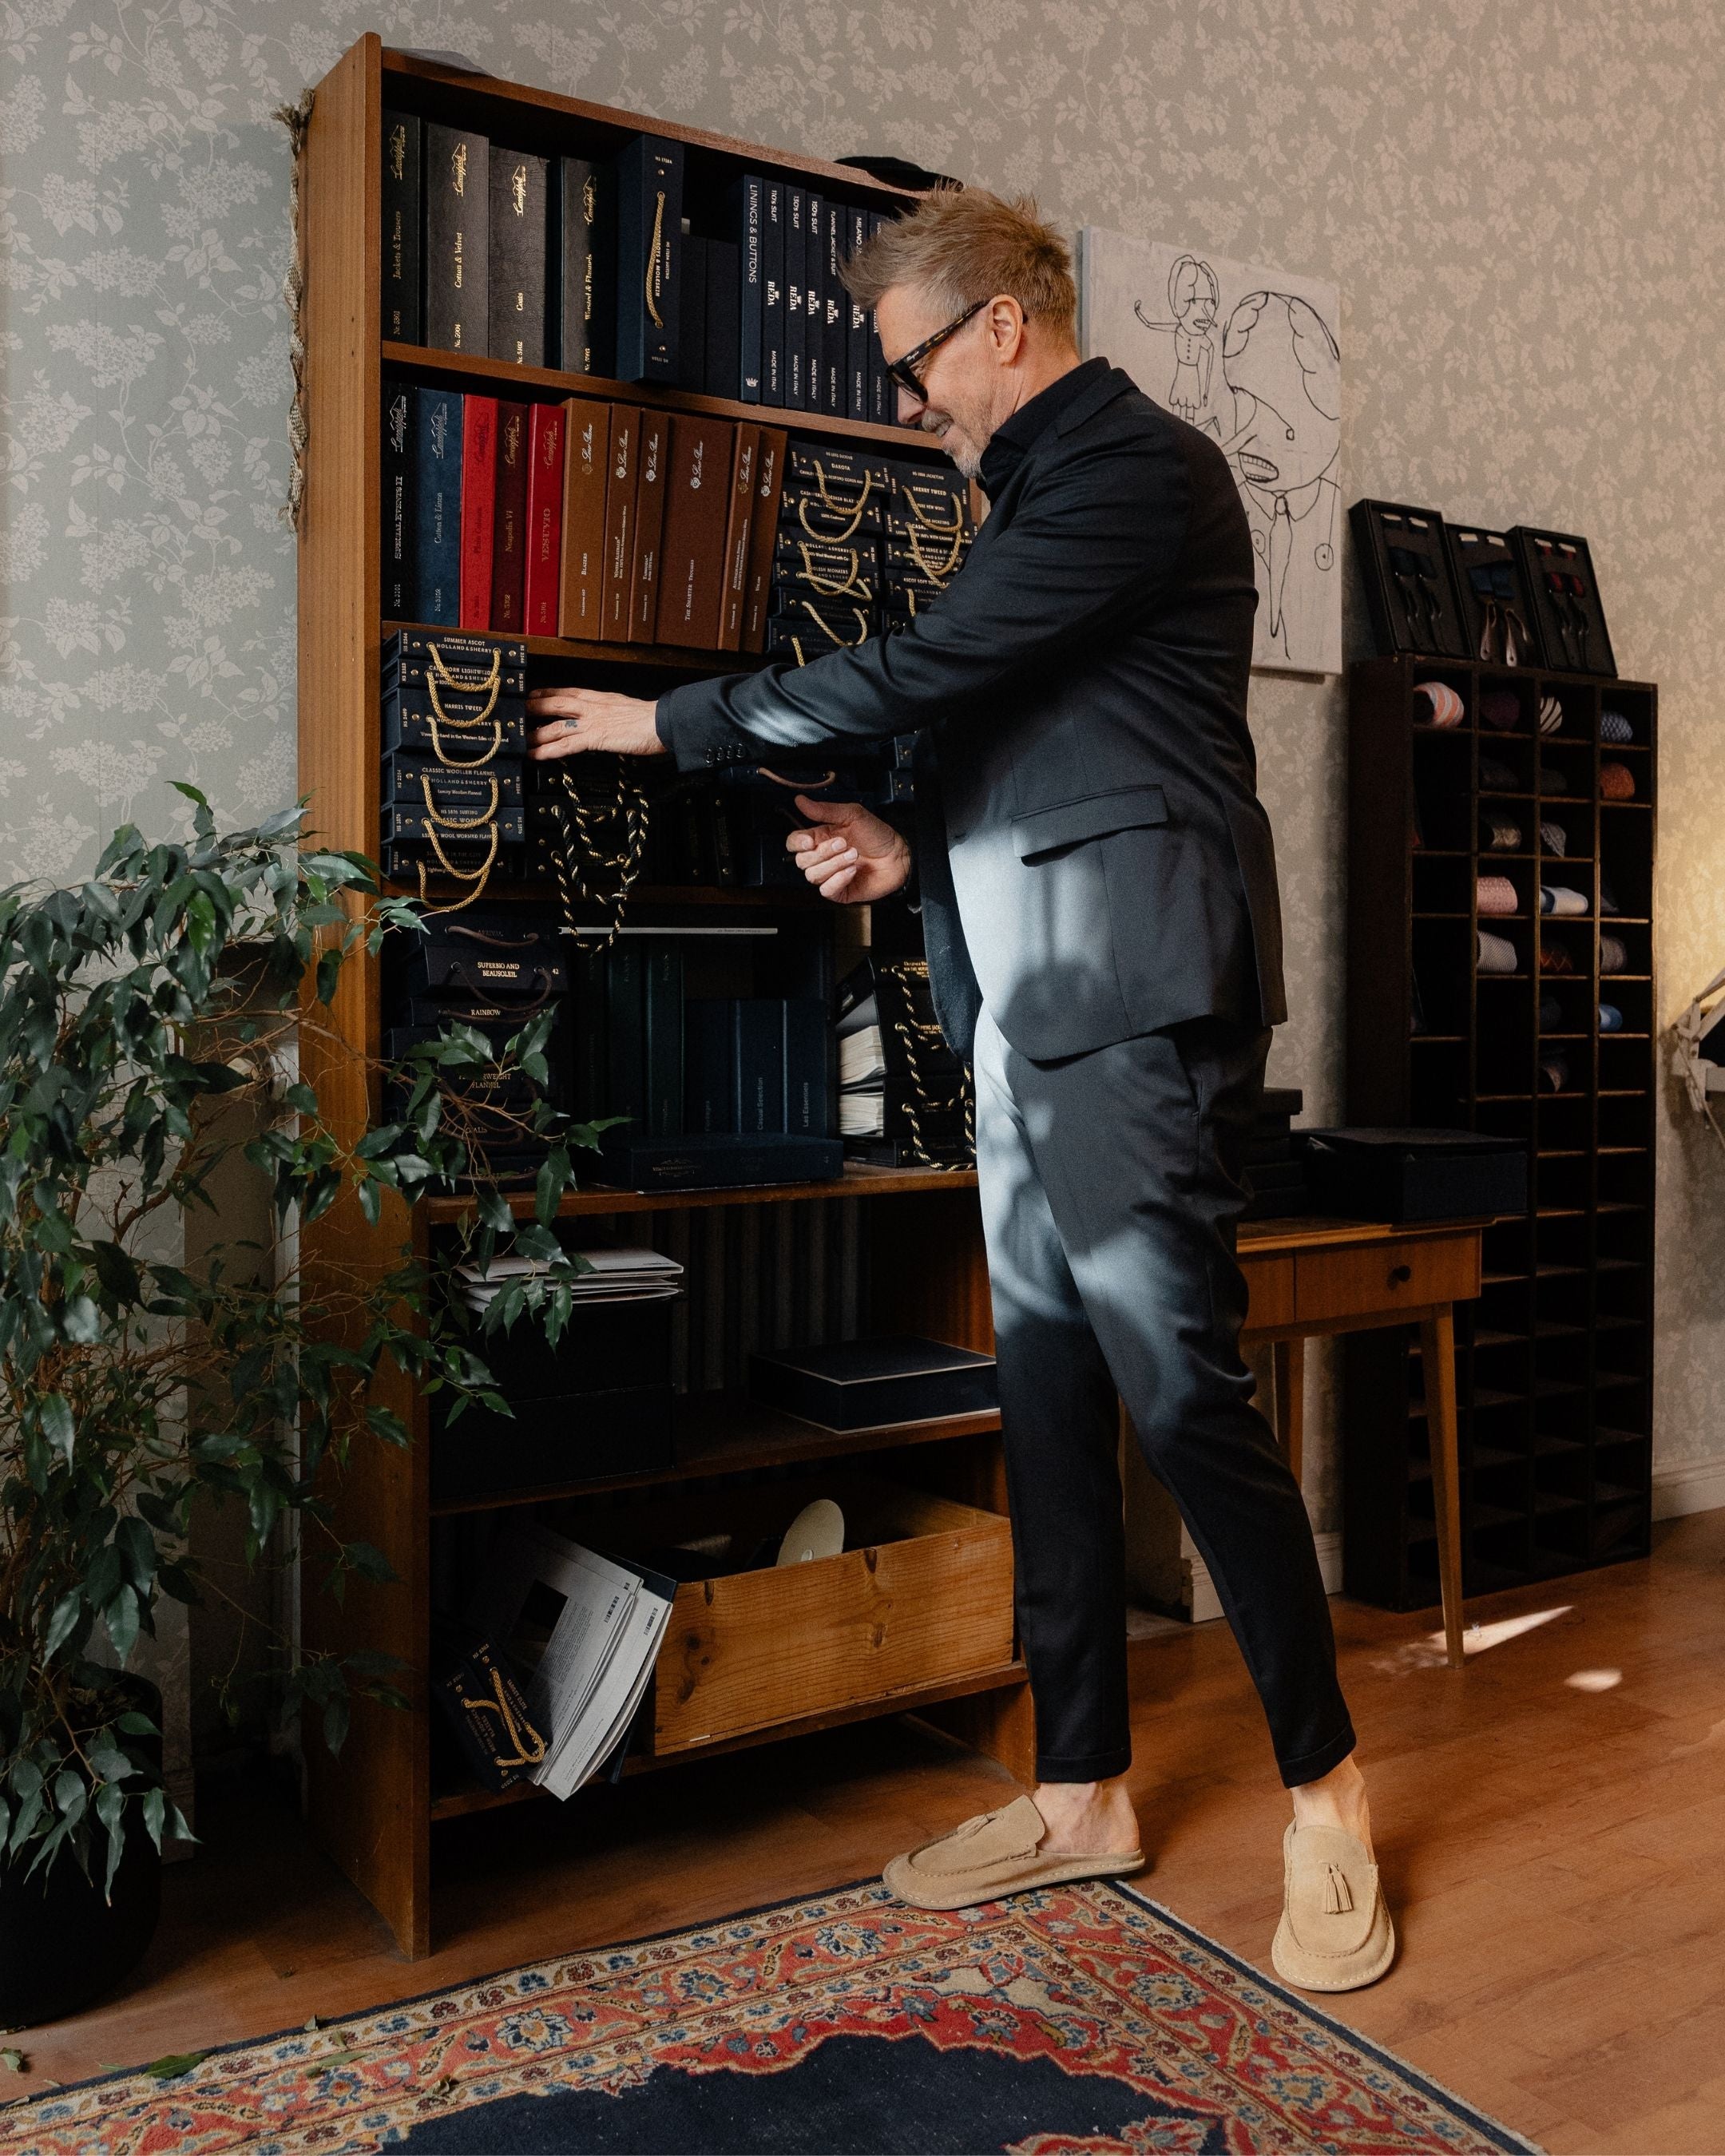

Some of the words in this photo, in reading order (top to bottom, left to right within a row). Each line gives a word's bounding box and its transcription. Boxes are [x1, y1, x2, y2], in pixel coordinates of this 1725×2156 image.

[748, 236, 757, 283] BUTTONS
[582, 423, 592, 444] Piana
[619, 429, 629, 447] Piana
[648, 433, 658, 453] Piana
[694, 441, 703, 459] Piana
[582, 444, 592, 462] Loro
[618, 448, 627, 468] Loro
[742, 446, 751, 465] Piana
[740, 466, 749, 482] Loro
[763, 469, 772, 486] Loro
